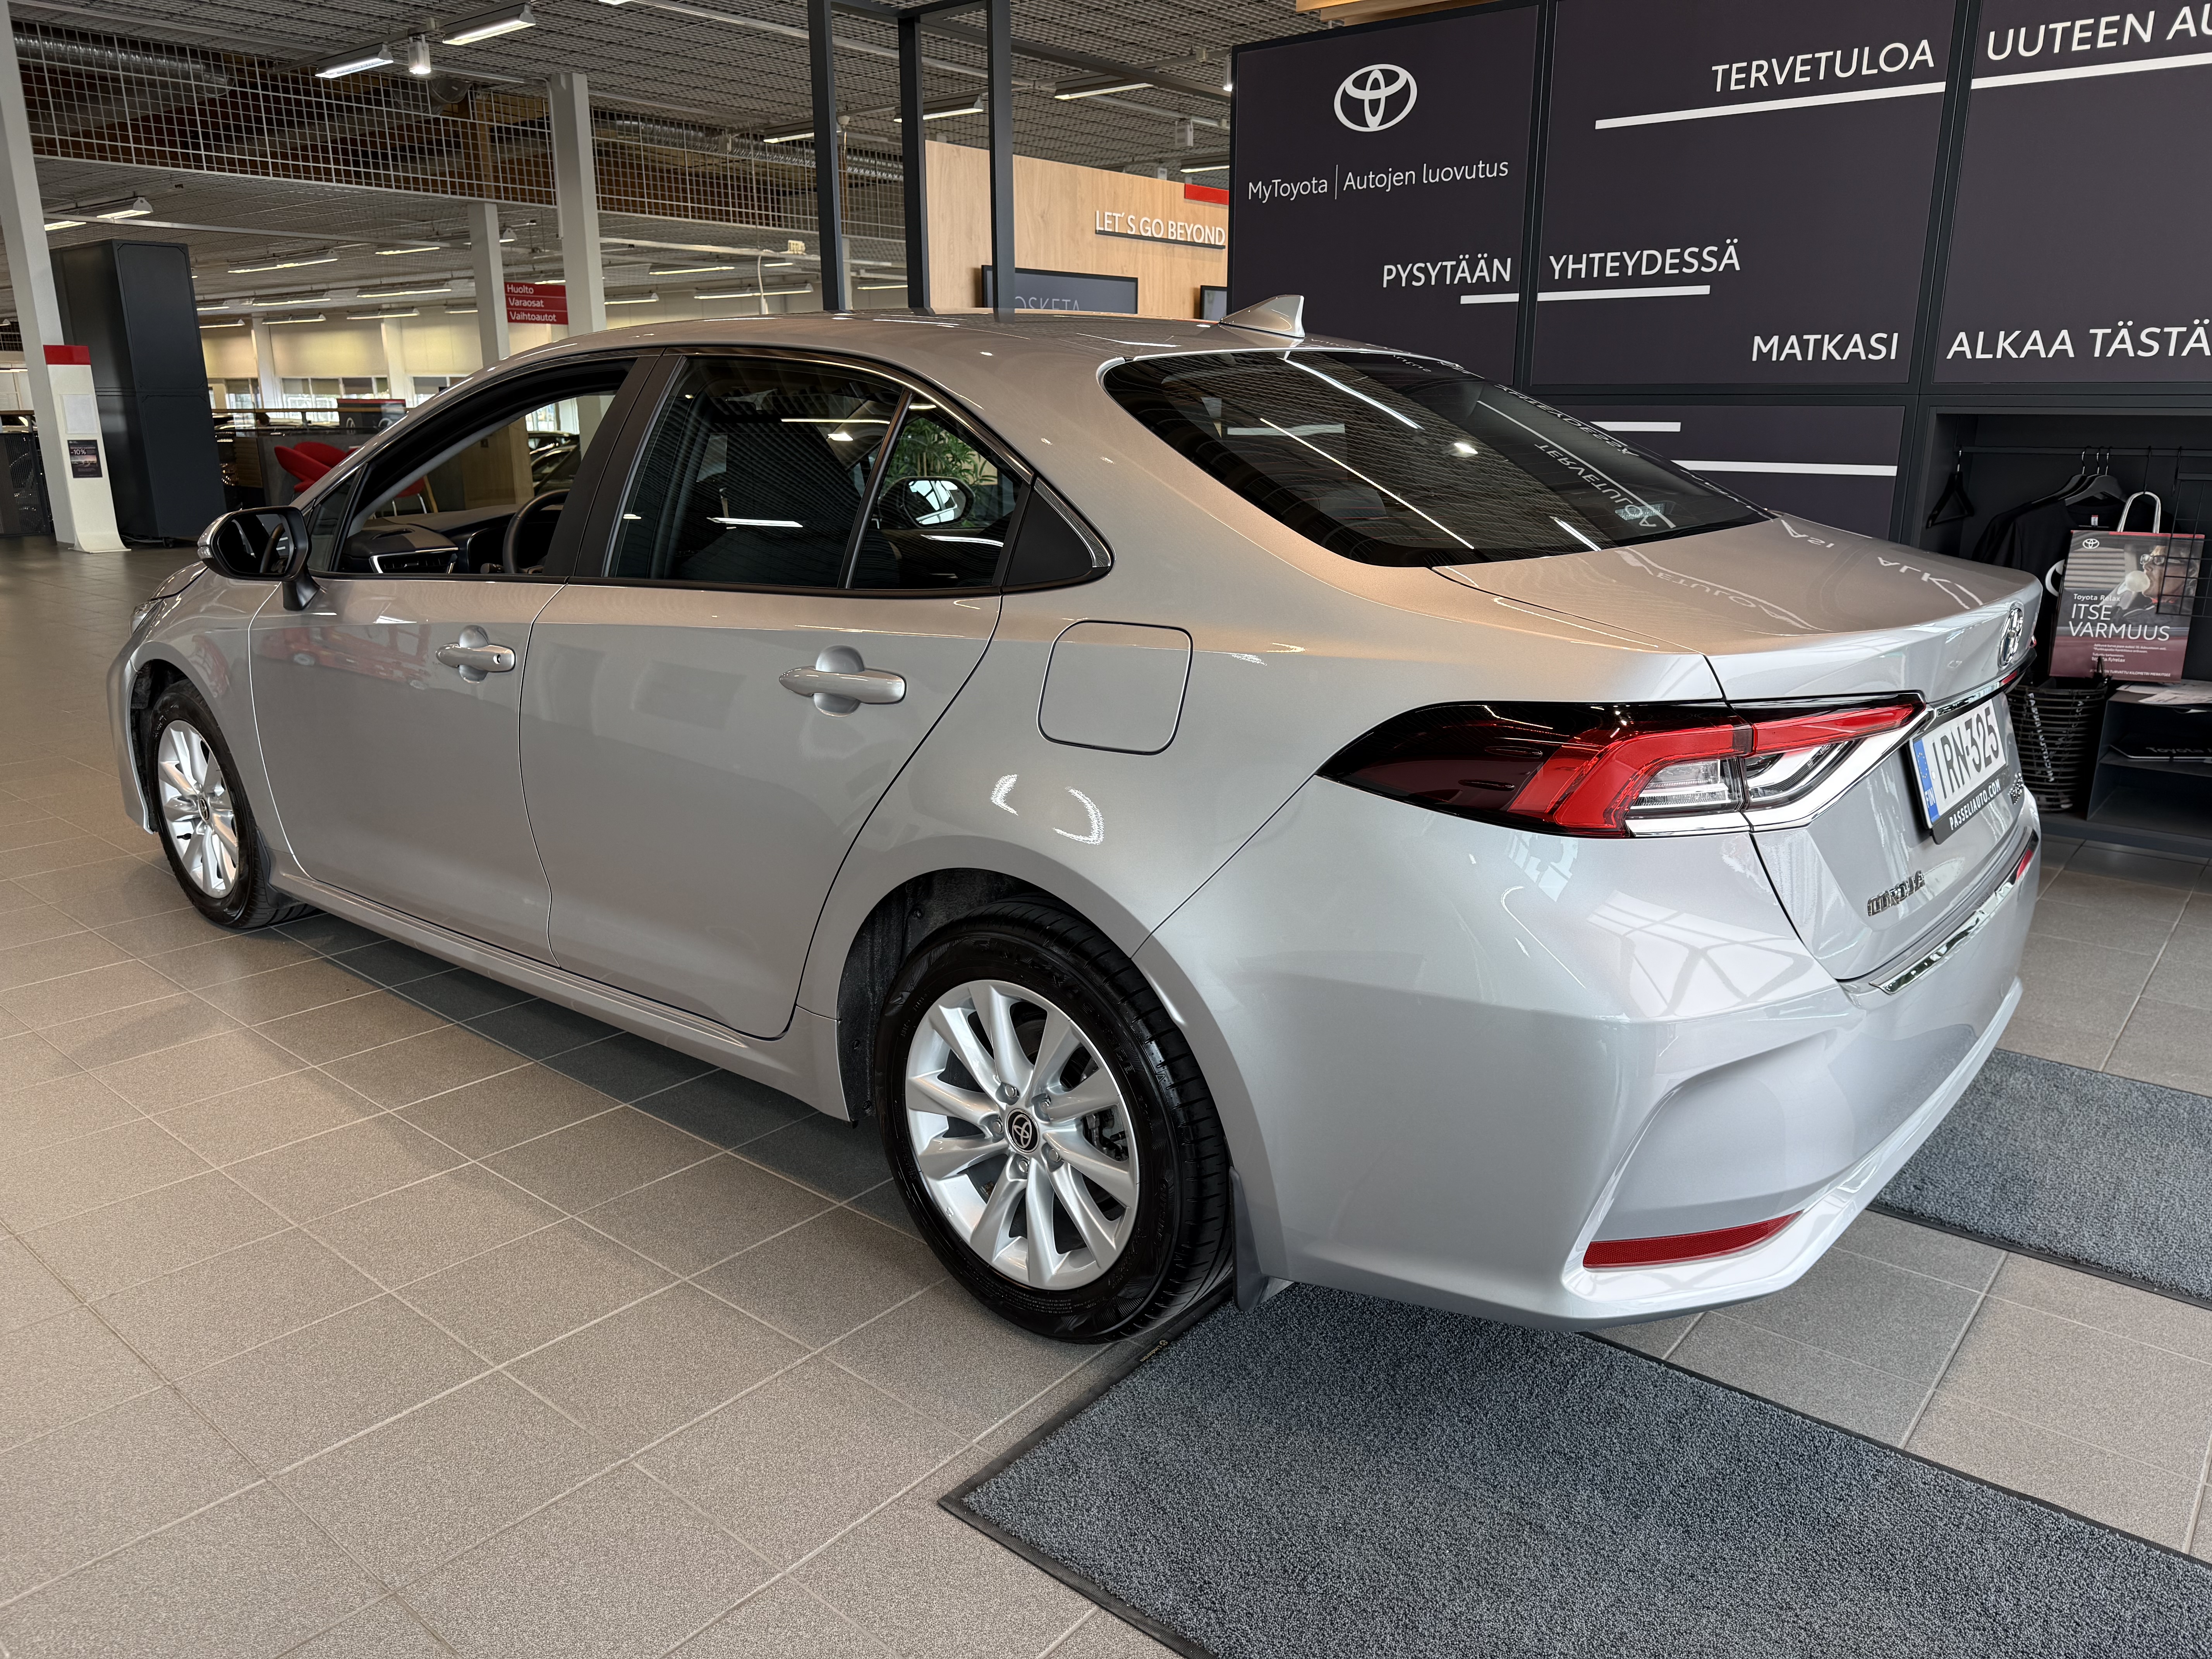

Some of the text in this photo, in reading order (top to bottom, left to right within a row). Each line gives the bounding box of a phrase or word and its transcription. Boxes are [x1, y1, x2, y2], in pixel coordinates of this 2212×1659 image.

[1712, 39, 1935, 93] TERVETULOA
[1987, 10, 2155, 61] UUTEEN
[1248, 160, 1508, 203] MyToyota Autojen luovutus
[1139, 217, 1164, 238] GO
[1168, 220, 1226, 245] BEYOND
[1382, 238, 1741, 288] PYSYTÄÄN YHTEYDESSÄ
[507, 284, 534, 294] Huolto
[508, 297, 544, 307] Varaosat
[509, 311, 557, 321] Vaihtoautot
[1752, 318, 2212, 362] MATKASI ALKAA TÄSTÄ
[2071, 603, 2112, 621] ITSE
[2068, 620, 2171, 641] VARMUUS
[1932, 706, 1999, 800] IRN-325
[1924, 787, 1936, 808] FIN
[1949, 778, 2001, 831] PASSELIAUTO.COM
